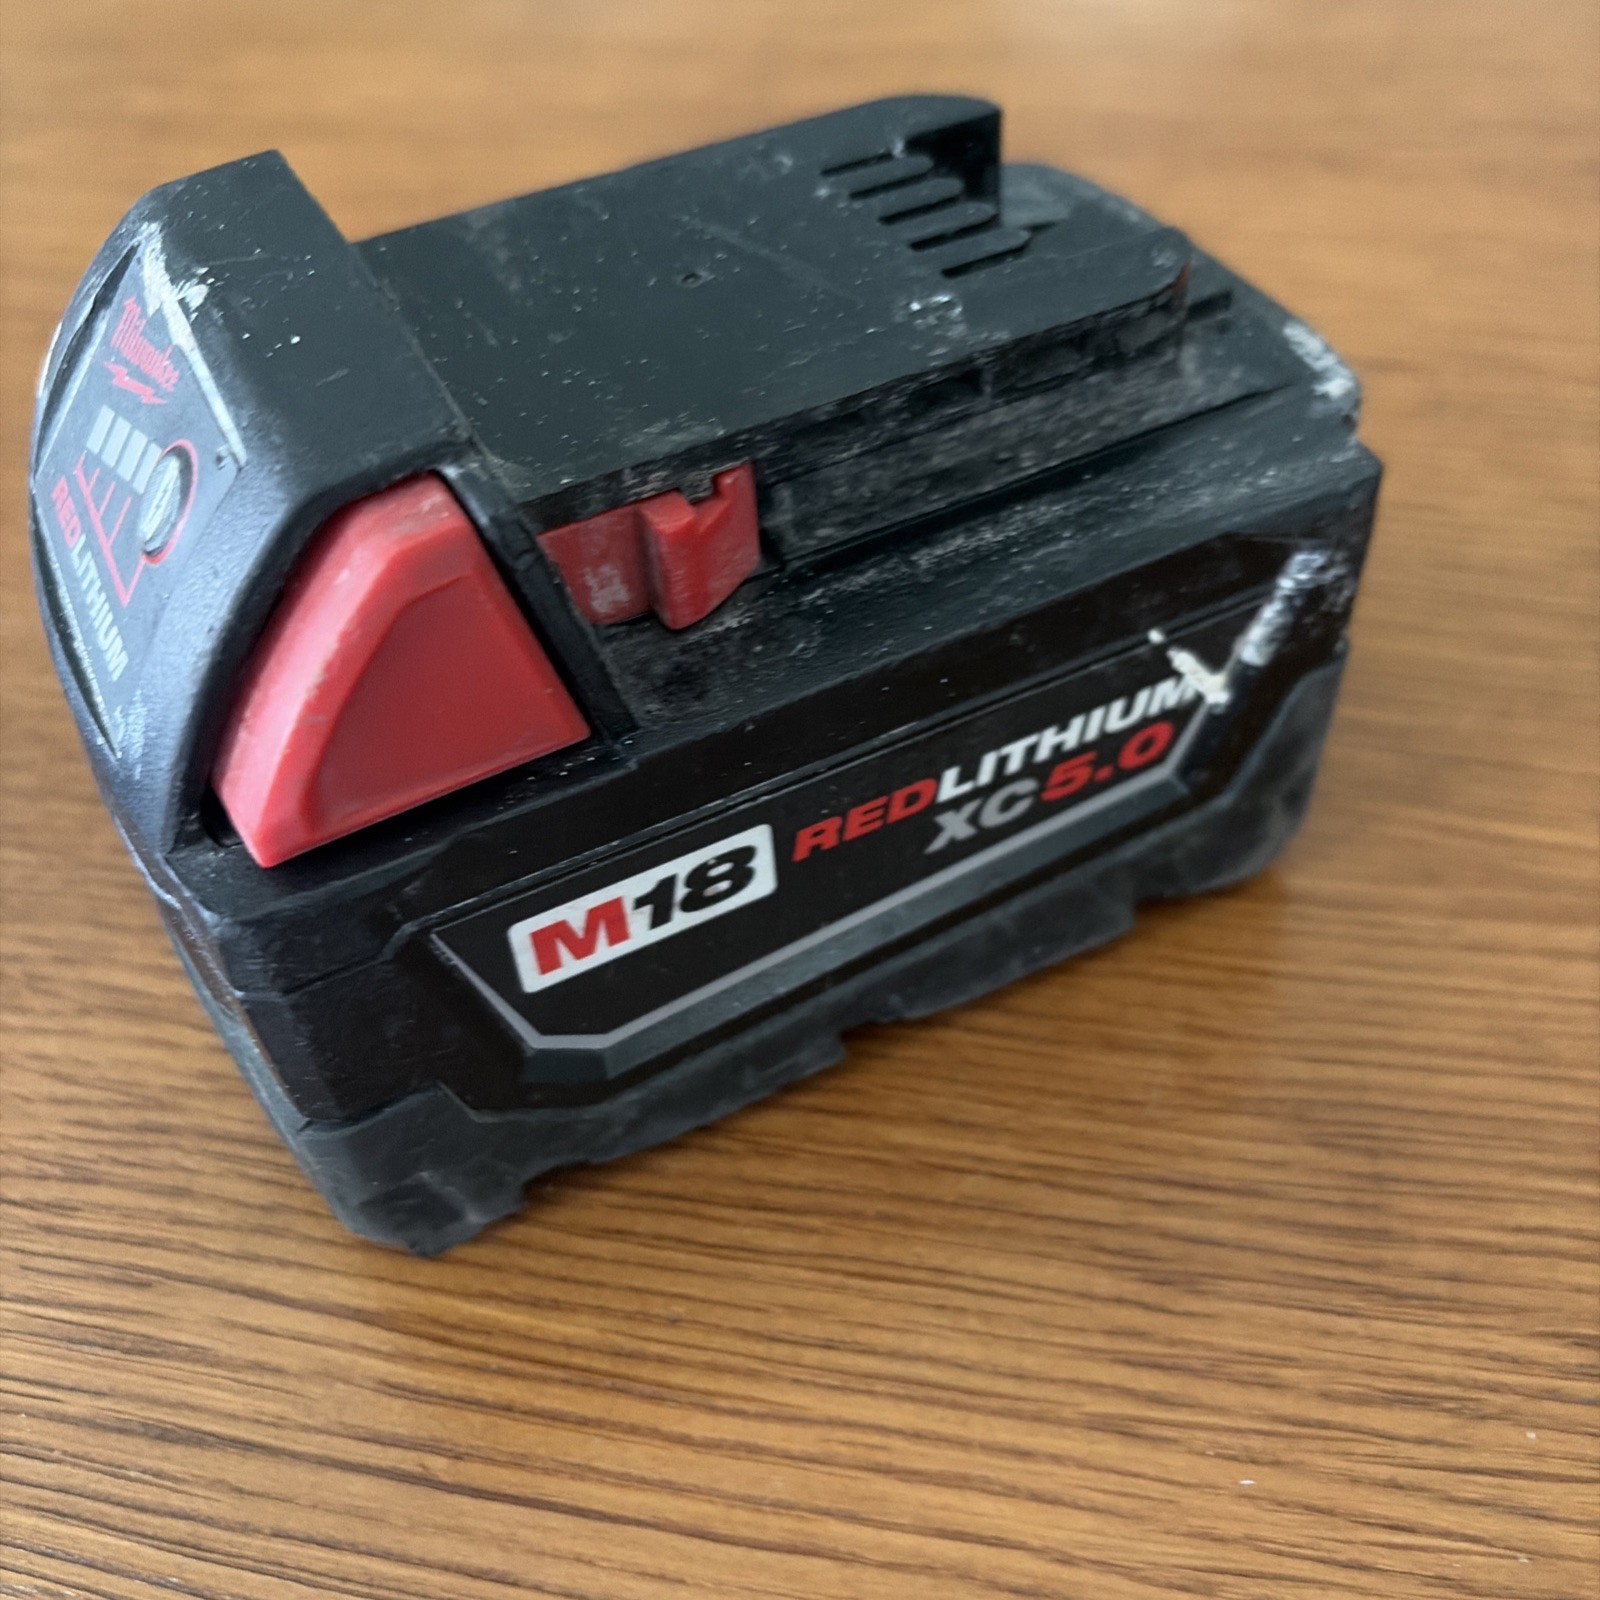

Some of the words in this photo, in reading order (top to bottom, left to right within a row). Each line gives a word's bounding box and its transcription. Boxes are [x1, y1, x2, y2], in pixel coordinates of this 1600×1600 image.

[51, 475, 130, 683] REDLITHIUM
[529, 845, 758, 976] M18
[792, 674, 1199, 862] REDLITHIUM
[925, 777, 1041, 855] XC
[1040, 721, 1174, 801] 5.0
